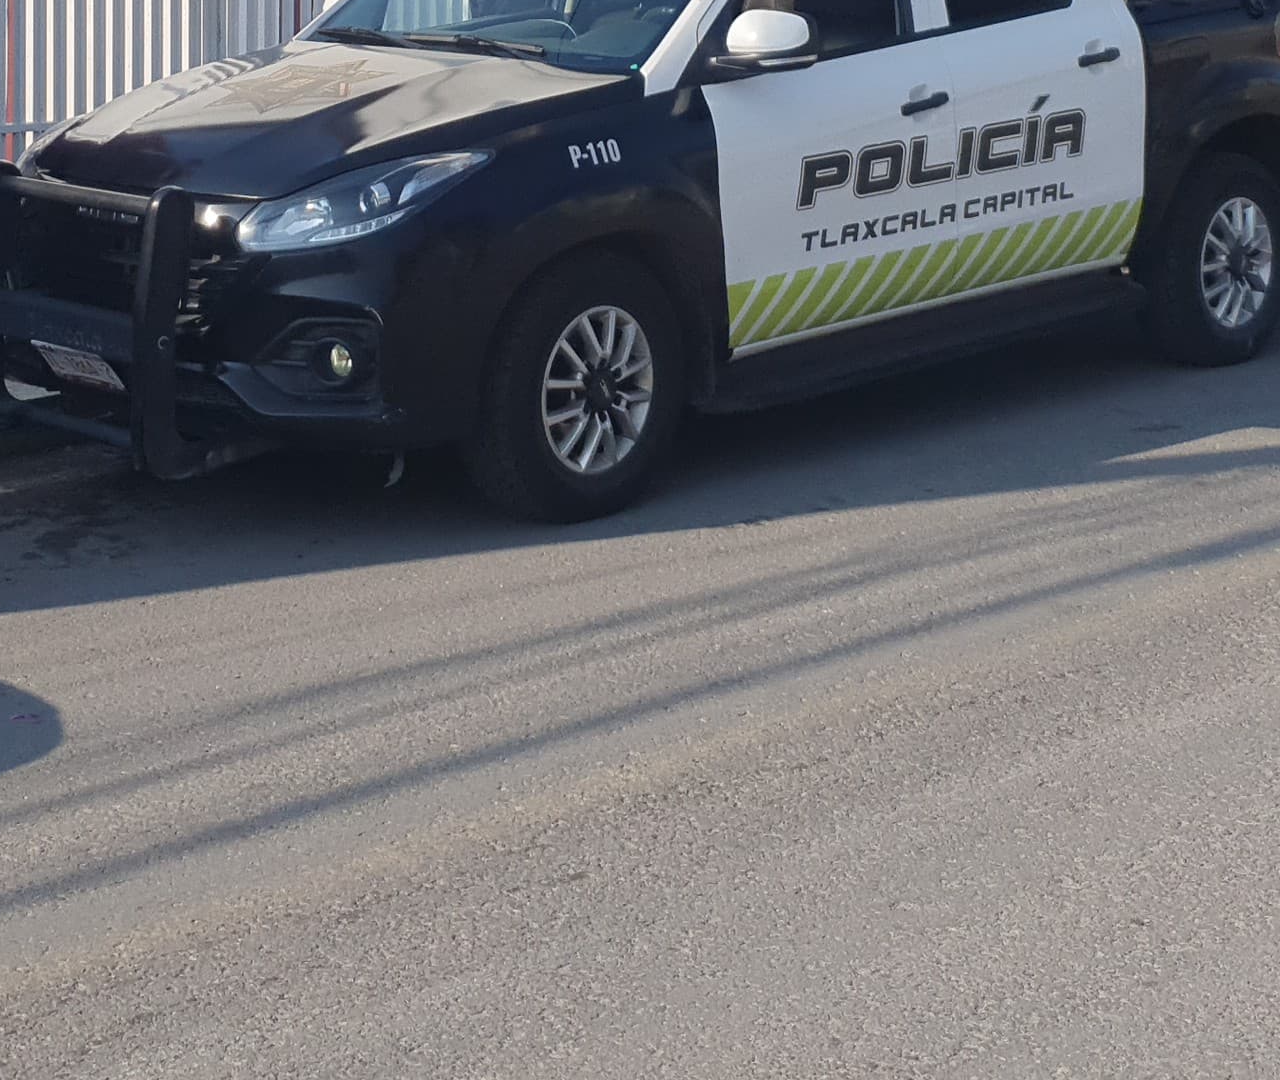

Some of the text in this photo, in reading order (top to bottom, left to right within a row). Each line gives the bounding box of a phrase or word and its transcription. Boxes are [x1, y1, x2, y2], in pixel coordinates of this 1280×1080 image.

[567, 138, 621, 168] P-110
[796, 94, 1086, 211] POLICÍA
[802, 182, 1073, 252] TLAXCALA CAPITAL
